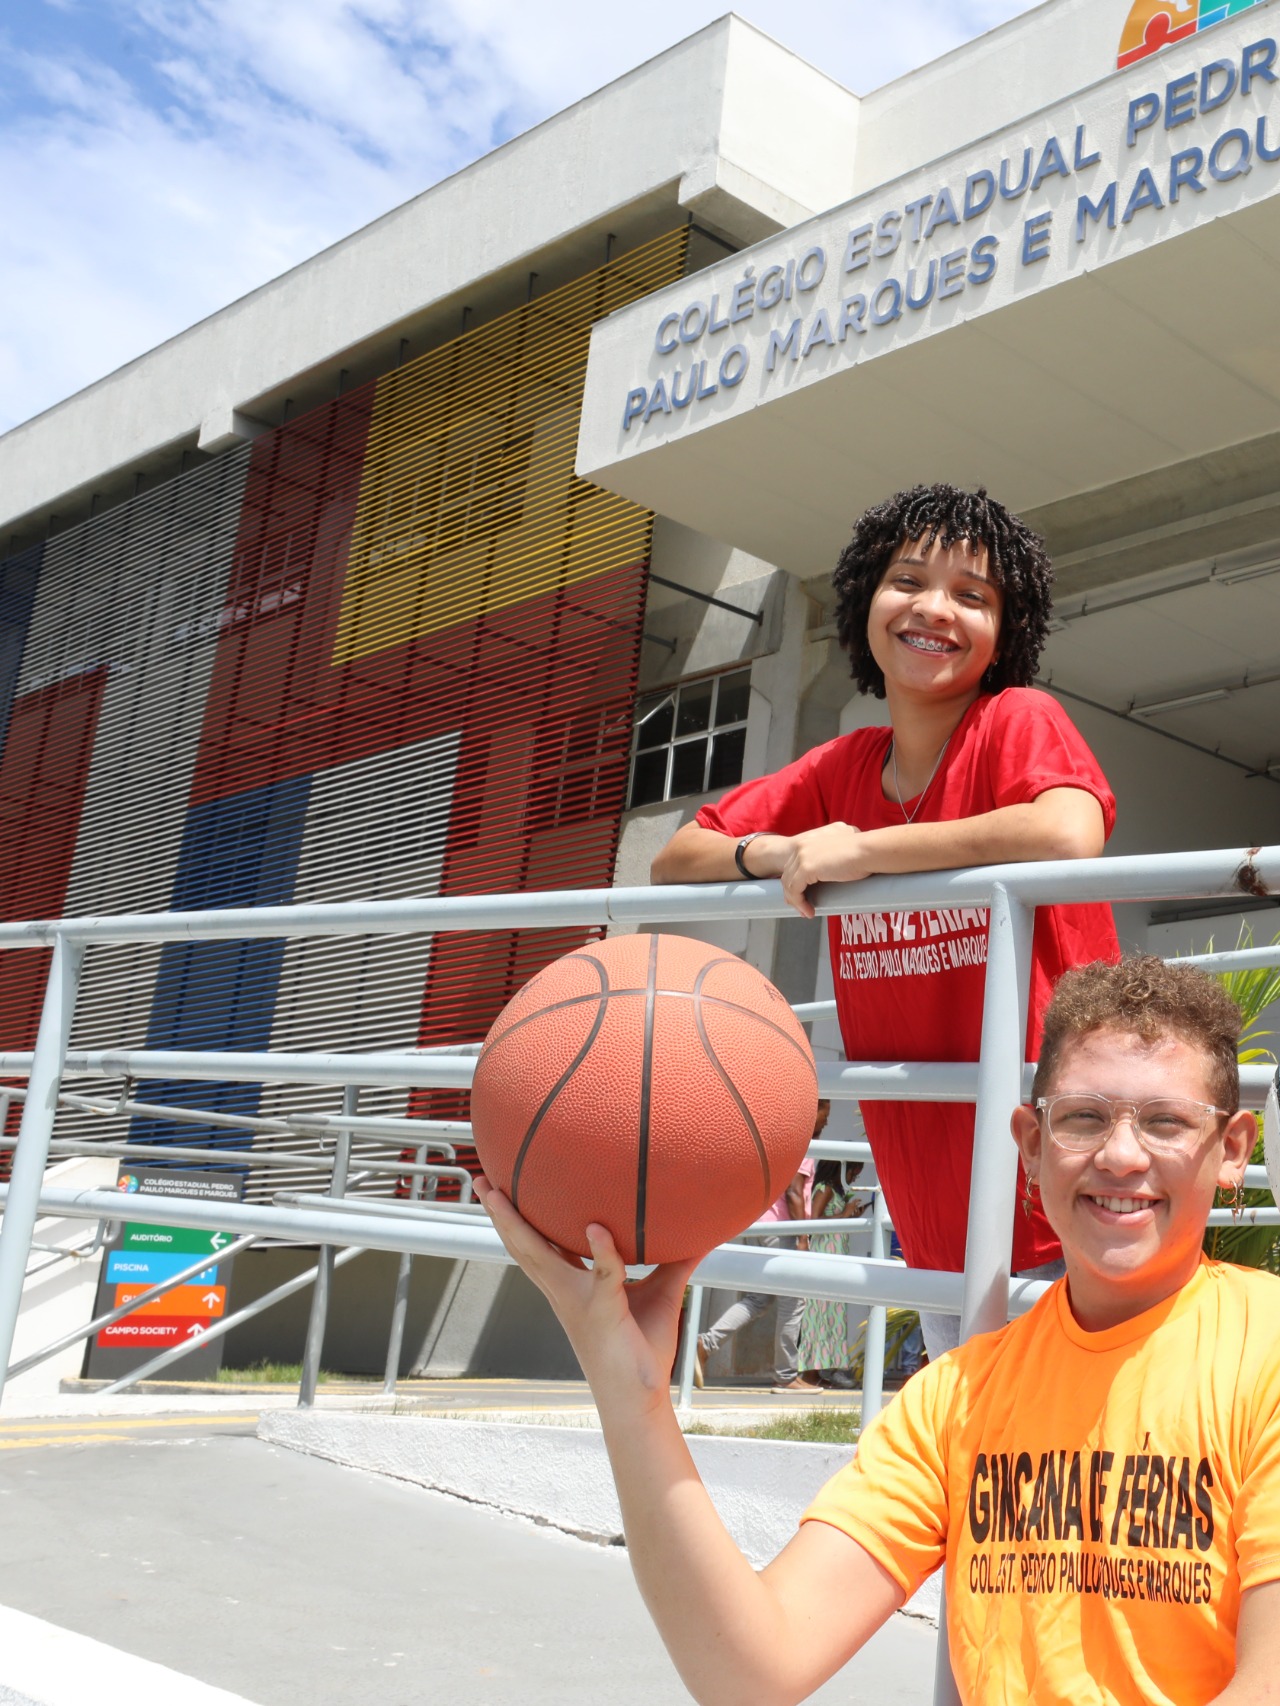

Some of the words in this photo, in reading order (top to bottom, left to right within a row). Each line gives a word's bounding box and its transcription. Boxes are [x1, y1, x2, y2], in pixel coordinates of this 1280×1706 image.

[654, 245, 828, 356] COLÉGIO
[844, 123, 1102, 274] ESTADUAL
[621, 343, 748, 431] PAULO
[765, 235, 1000, 372] MARQUES
[1021, 212, 1053, 266] E
[854, 951, 878, 980] PEDRO
[879, 949, 902, 978] PAULO
[902, 943, 941, 976] MARQUES
[939, 942, 950, 971] E
[947, 934, 988, 969] MARQUE
[144, 1178, 174, 1186] COLÉGIO
[175, 1181, 210, 1189] ESTADUAL
[165, 1187, 198, 1195] MARQUES
[204, 1190, 238, 1198] MARQUES
[130, 1234, 173, 1242] AUDITÓRIO
[114, 1263, 149, 1272] PISCINA
[105, 1326, 138, 1335] CAMPO
[140, 1326, 178, 1335] SOCIETY
[968, 1450, 1084, 1544] GINCANA
[1110, 1432, 1214, 1552] FÉRIAS
[1020, 1552, 1057, 1594] PEDRO
[1100, 1556, 1136, 1601] QUES
[1137, 1560, 1146, 1600] E
[1146, 1560, 1212, 1605] MARQUES
